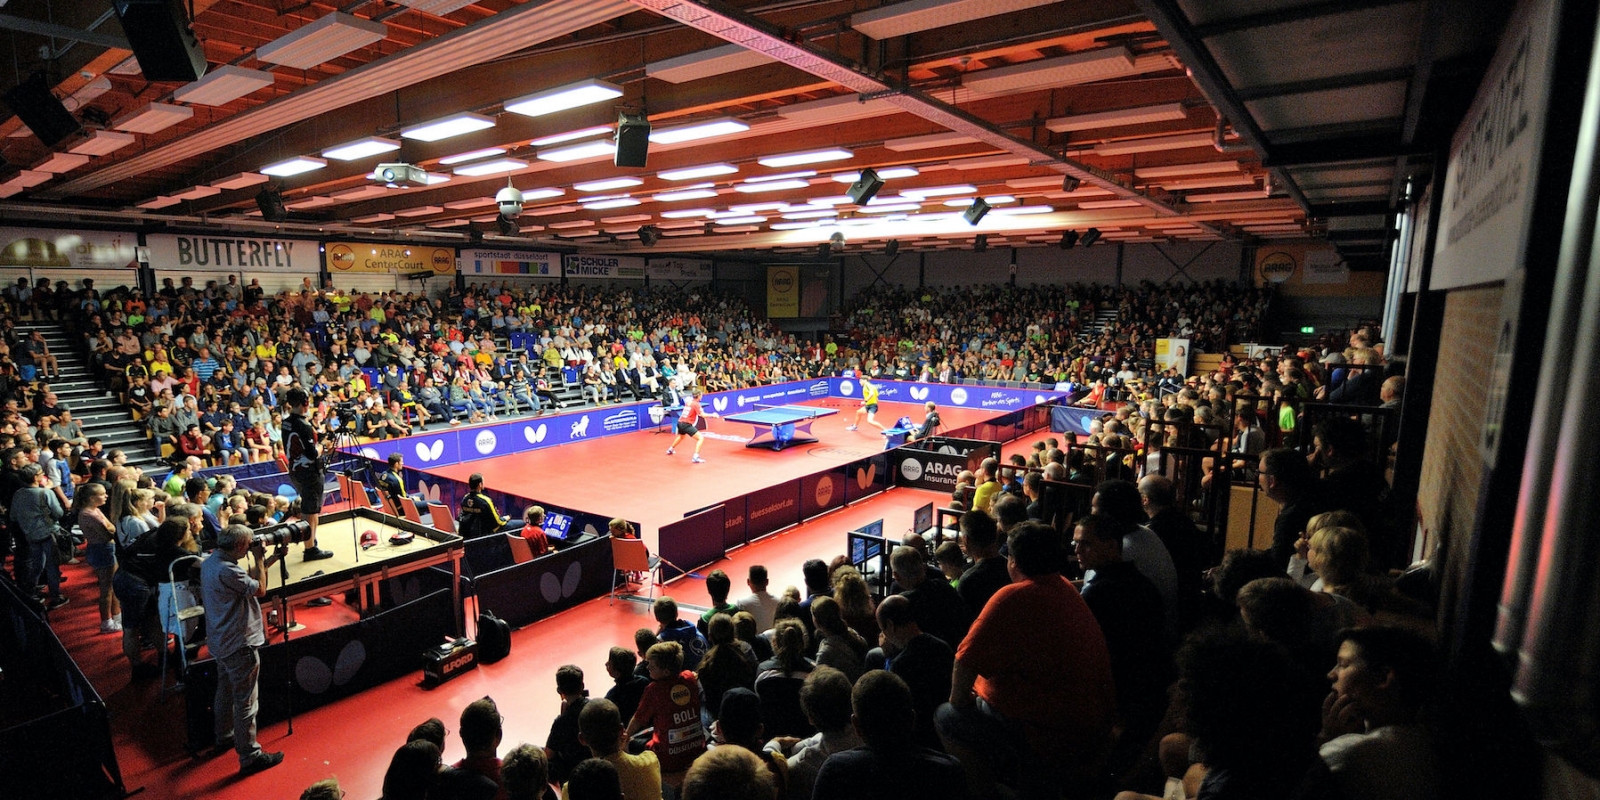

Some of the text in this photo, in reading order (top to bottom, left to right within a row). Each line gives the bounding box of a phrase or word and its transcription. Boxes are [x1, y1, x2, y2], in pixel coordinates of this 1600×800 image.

[177, 237, 293, 267] BUTTERFLY
[380, 249, 409, 259] ARAG
[473, 252, 511, 260] sportstadt
[365, 258, 424, 270] CenterCourt
[434, 256, 450, 265] ARAG
[456, 261, 462, 270] B
[581, 266, 609, 275] MICKE
[1264, 263, 1292, 272] ARAG
[477, 437, 494, 446] ARAG
[903, 466, 920, 474] ARAG
[925, 461, 962, 477] ARAG
[924, 474, 957, 485] Insuranc
[818, 485, 831, 497] ARAG
[750, 498, 794, 520] duesseldorf.de
[547, 516, 554, 527] 4
[560, 519, 568, 530] 6
[443, 652, 475, 674] ILFORD
[672, 707, 698, 724] BOLL
